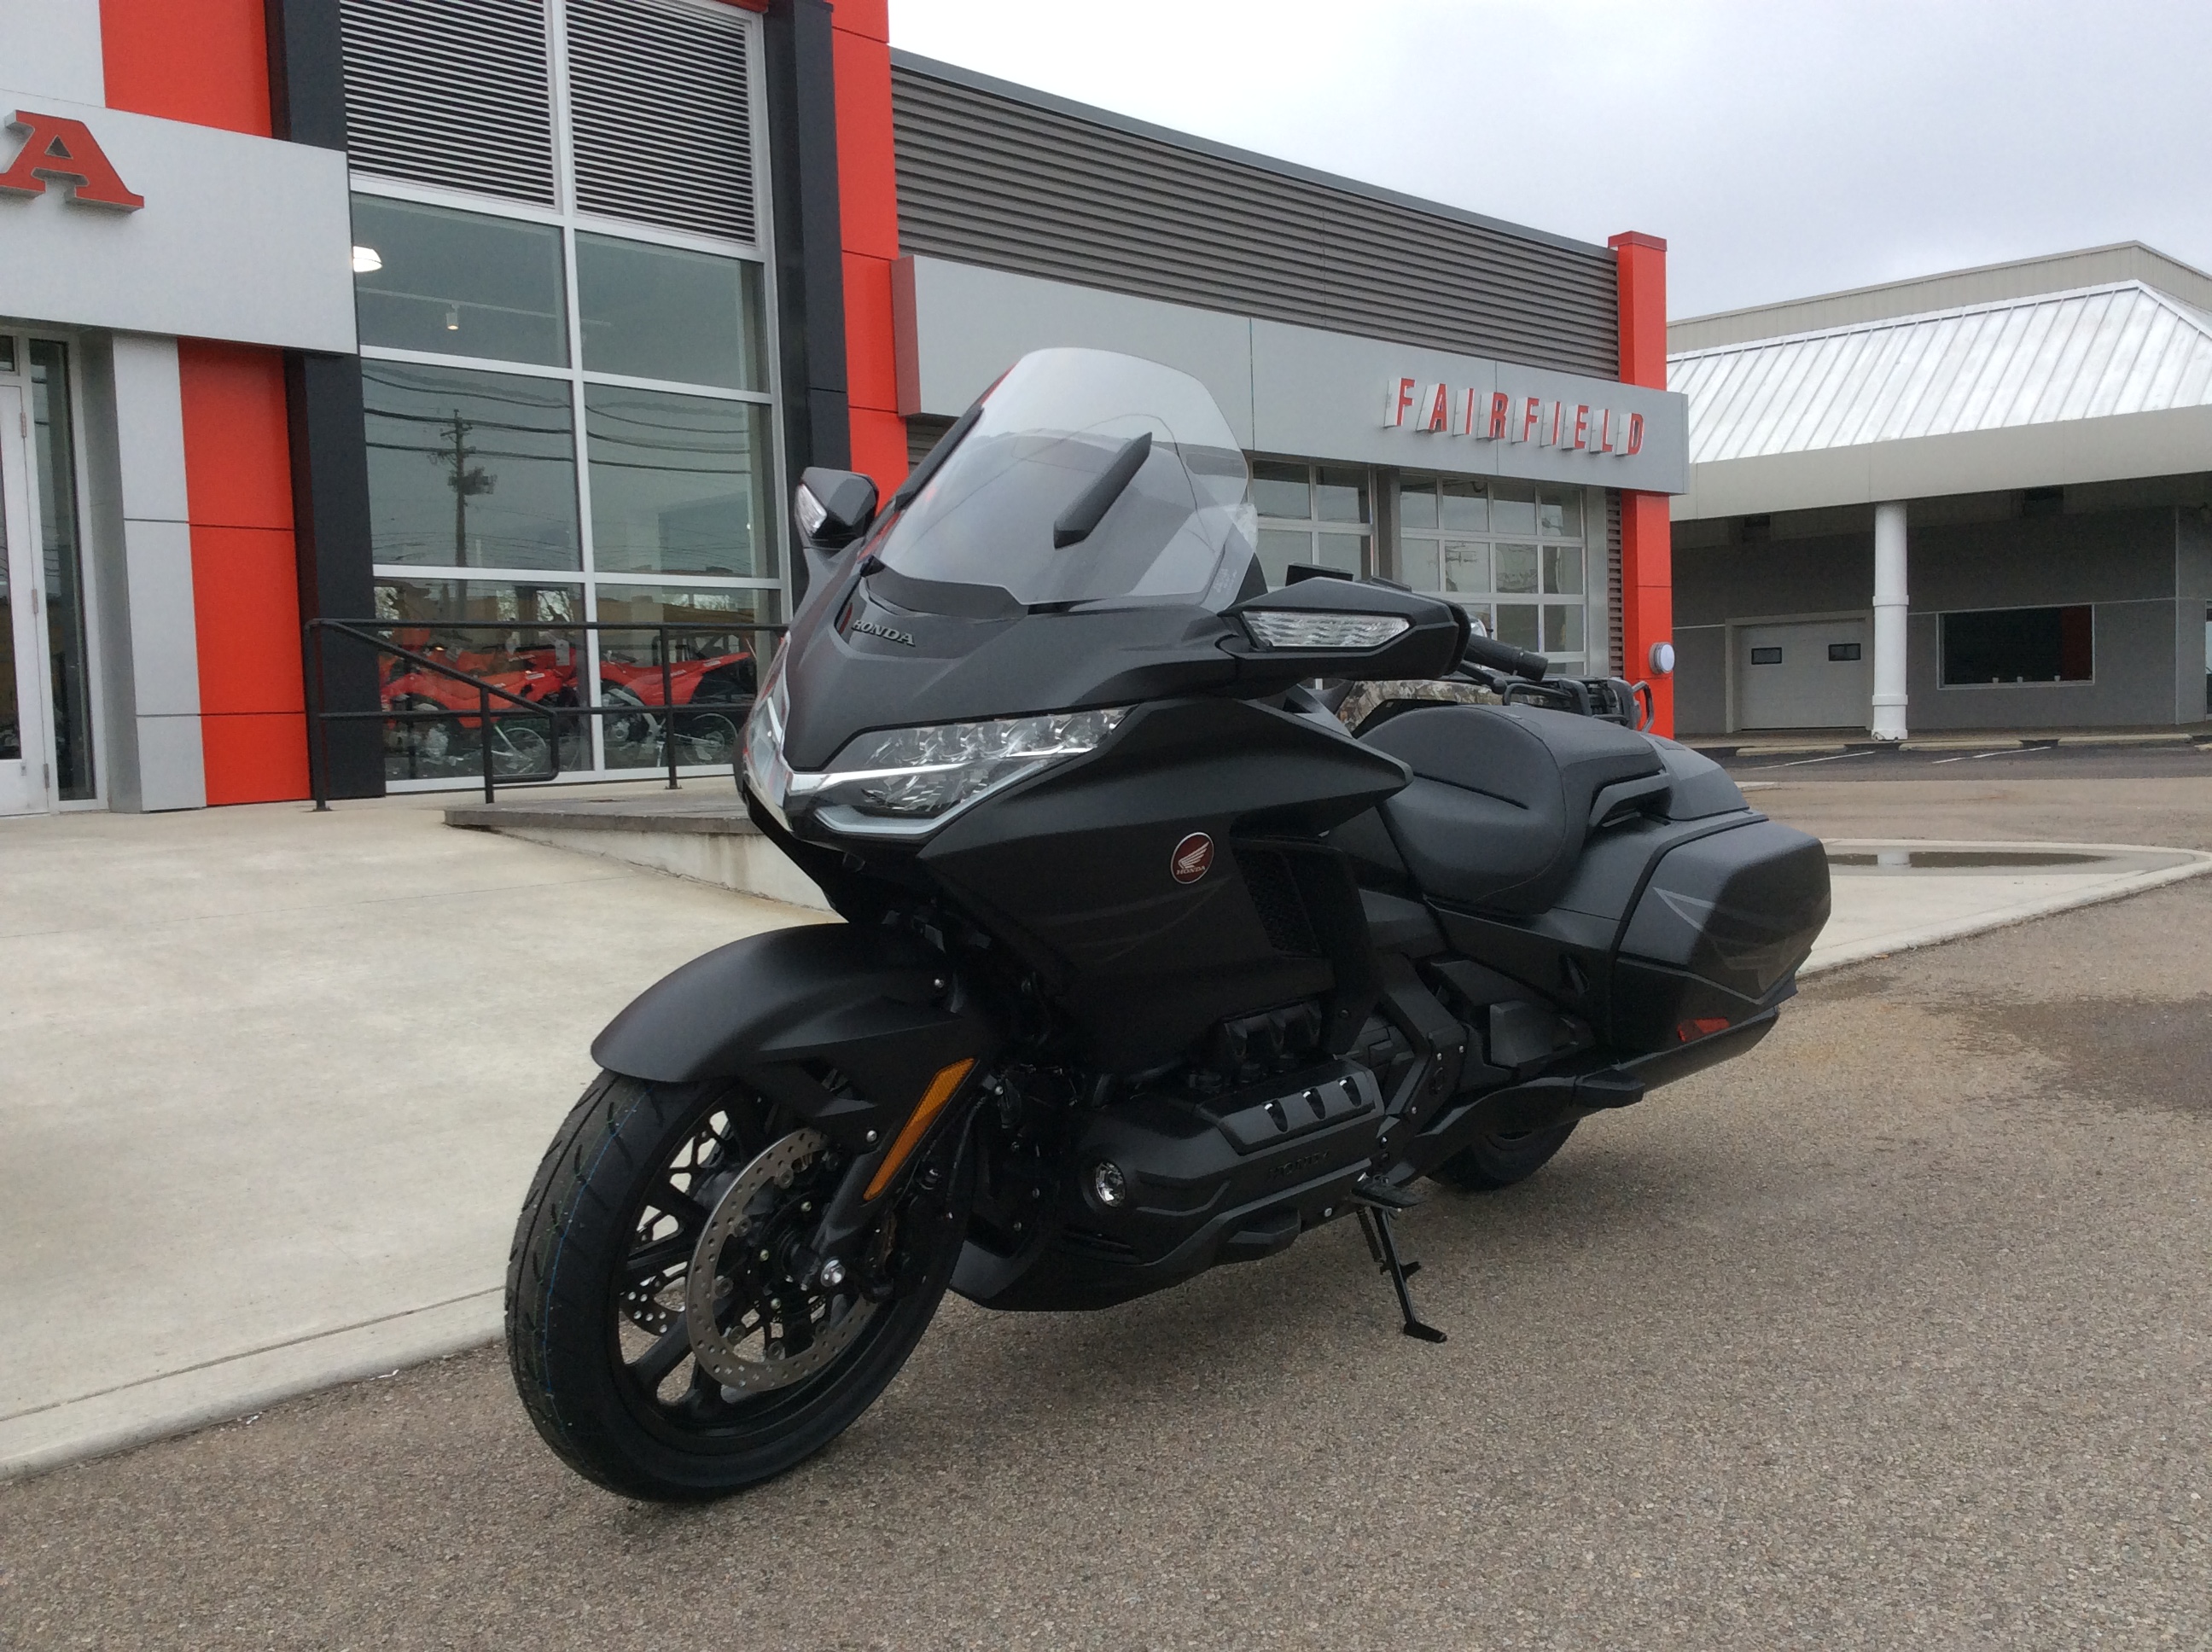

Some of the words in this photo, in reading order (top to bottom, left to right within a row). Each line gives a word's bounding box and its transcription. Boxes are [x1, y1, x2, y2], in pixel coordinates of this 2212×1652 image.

[1384, 376, 1645, 457] FAIRFIELD
[852, 620, 915, 647] HONDA
[1176, 865, 1206, 875] HONDA
